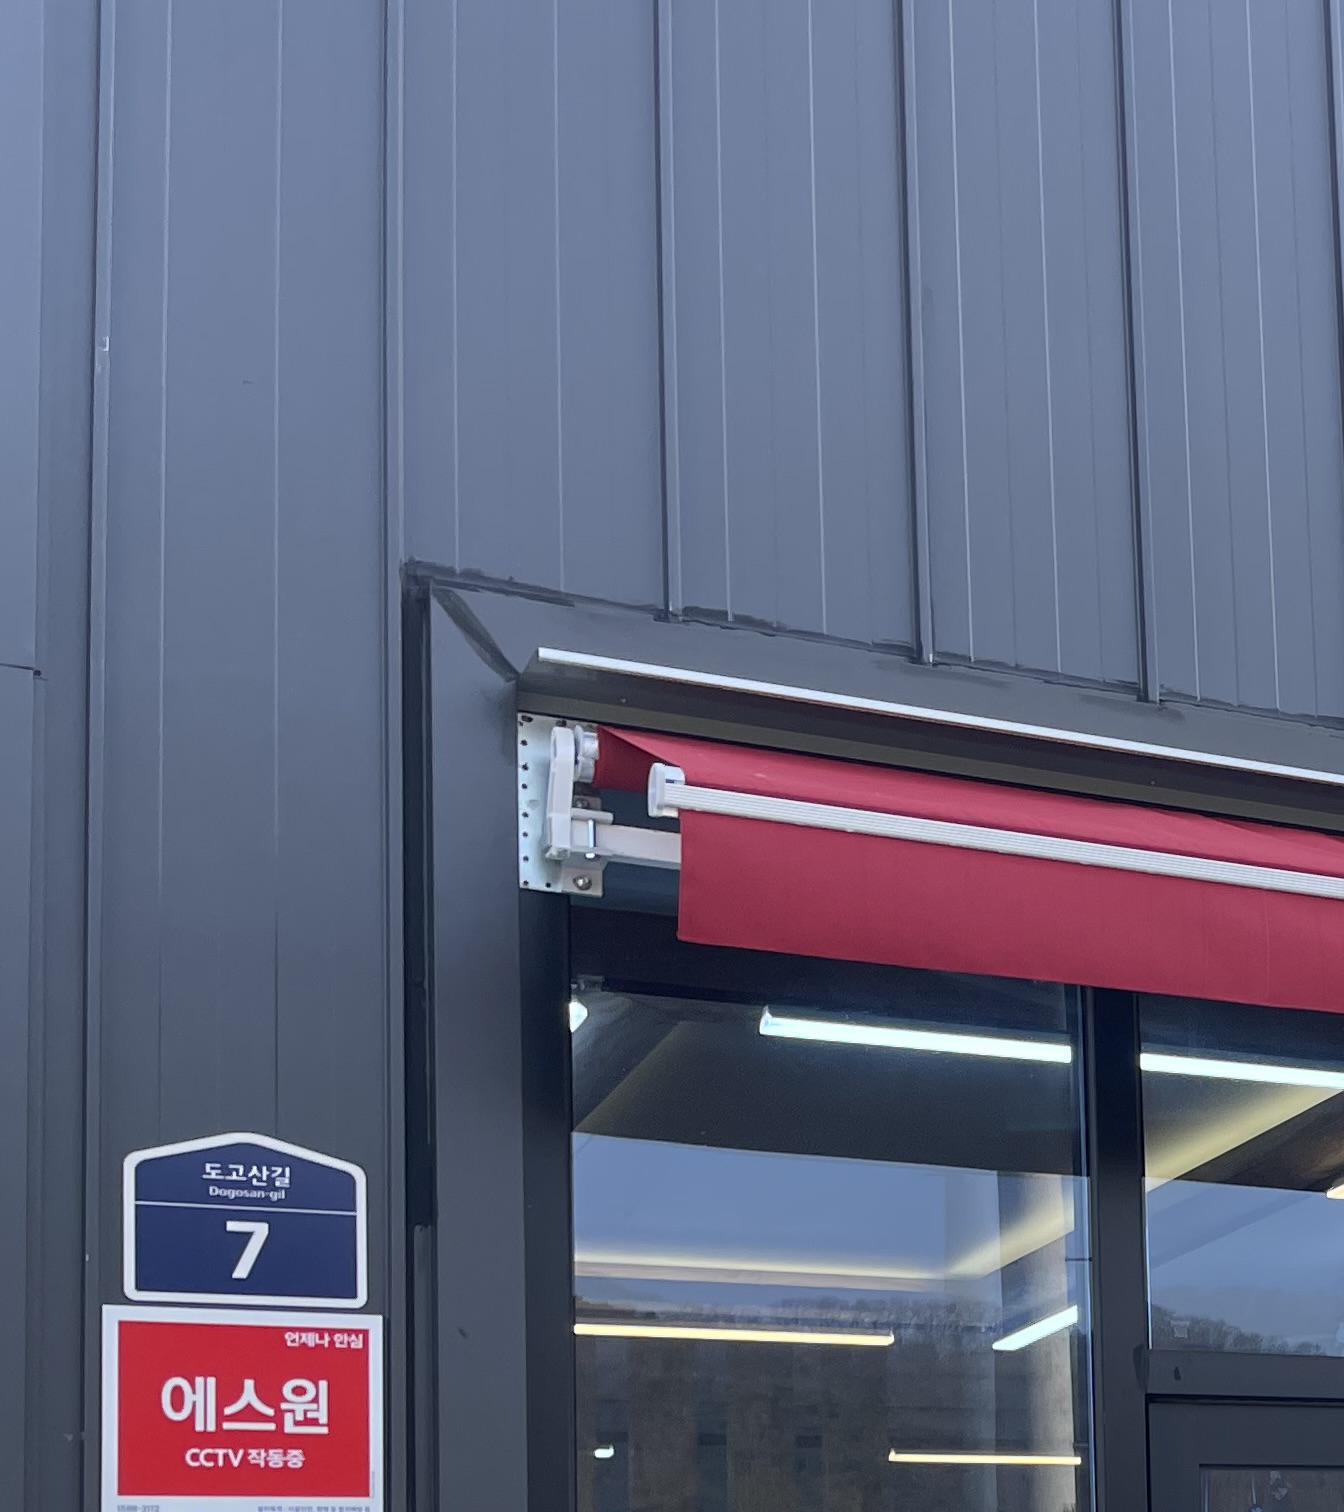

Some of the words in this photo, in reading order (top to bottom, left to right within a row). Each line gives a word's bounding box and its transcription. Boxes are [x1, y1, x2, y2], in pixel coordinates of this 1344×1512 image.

[202, 1163, 291, 1188] 도고산길
[209, 1186, 286, 1202] Dogosan-gil
[225, 1220, 270, 1280] 7
[284, 1331, 331, 1348] 언제나
[333, 1332, 364, 1349] 안심
[161, 1376, 329, 1435] 에스원
[185, 1448, 244, 1468] CCTV
[248, 1449, 306, 1469] 작동중
